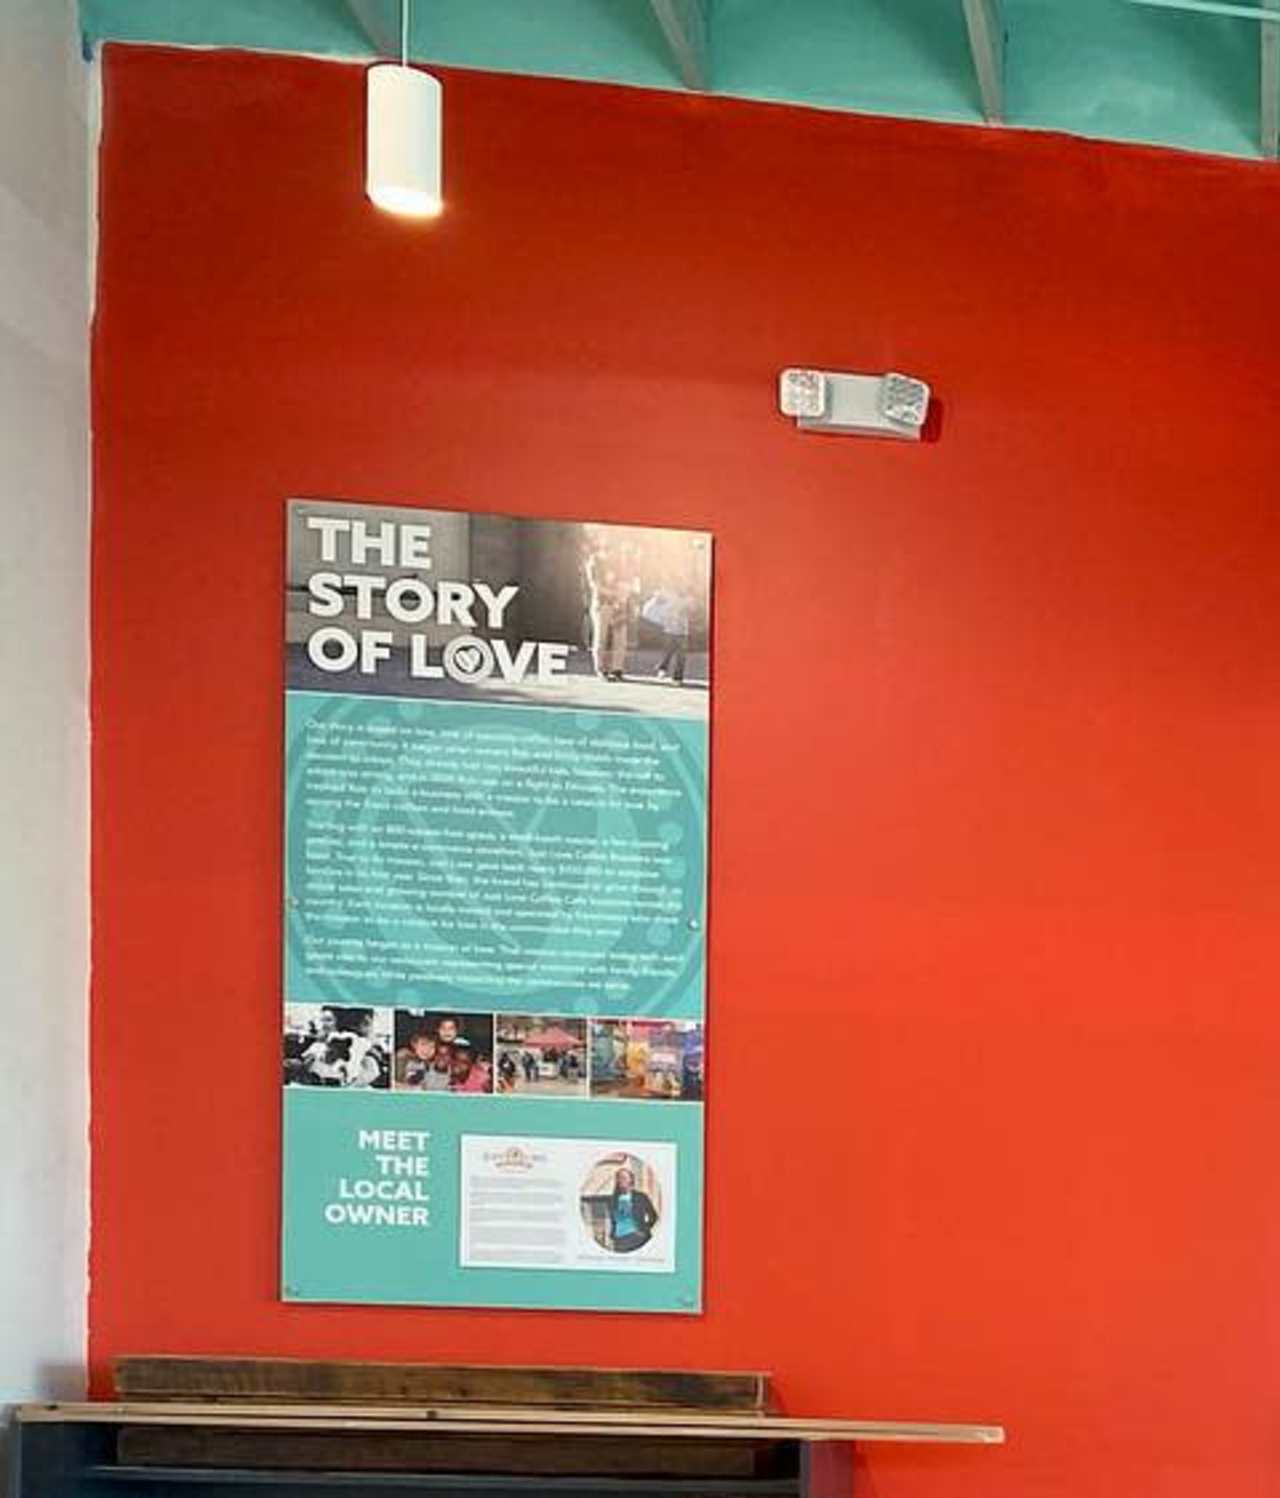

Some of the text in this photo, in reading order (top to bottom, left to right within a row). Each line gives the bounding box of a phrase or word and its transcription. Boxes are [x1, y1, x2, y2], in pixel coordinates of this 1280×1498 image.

[307, 516, 433, 569] THE
[307, 571, 519, 630] STORY
[307, 626, 572, 684] OF LOVE
[358, 1130, 430, 1151] MEET
[376, 1154, 429, 1178] THE
[340, 1178, 430, 1201] LOCAL
[325, 1203, 429, 1227] OWNER
